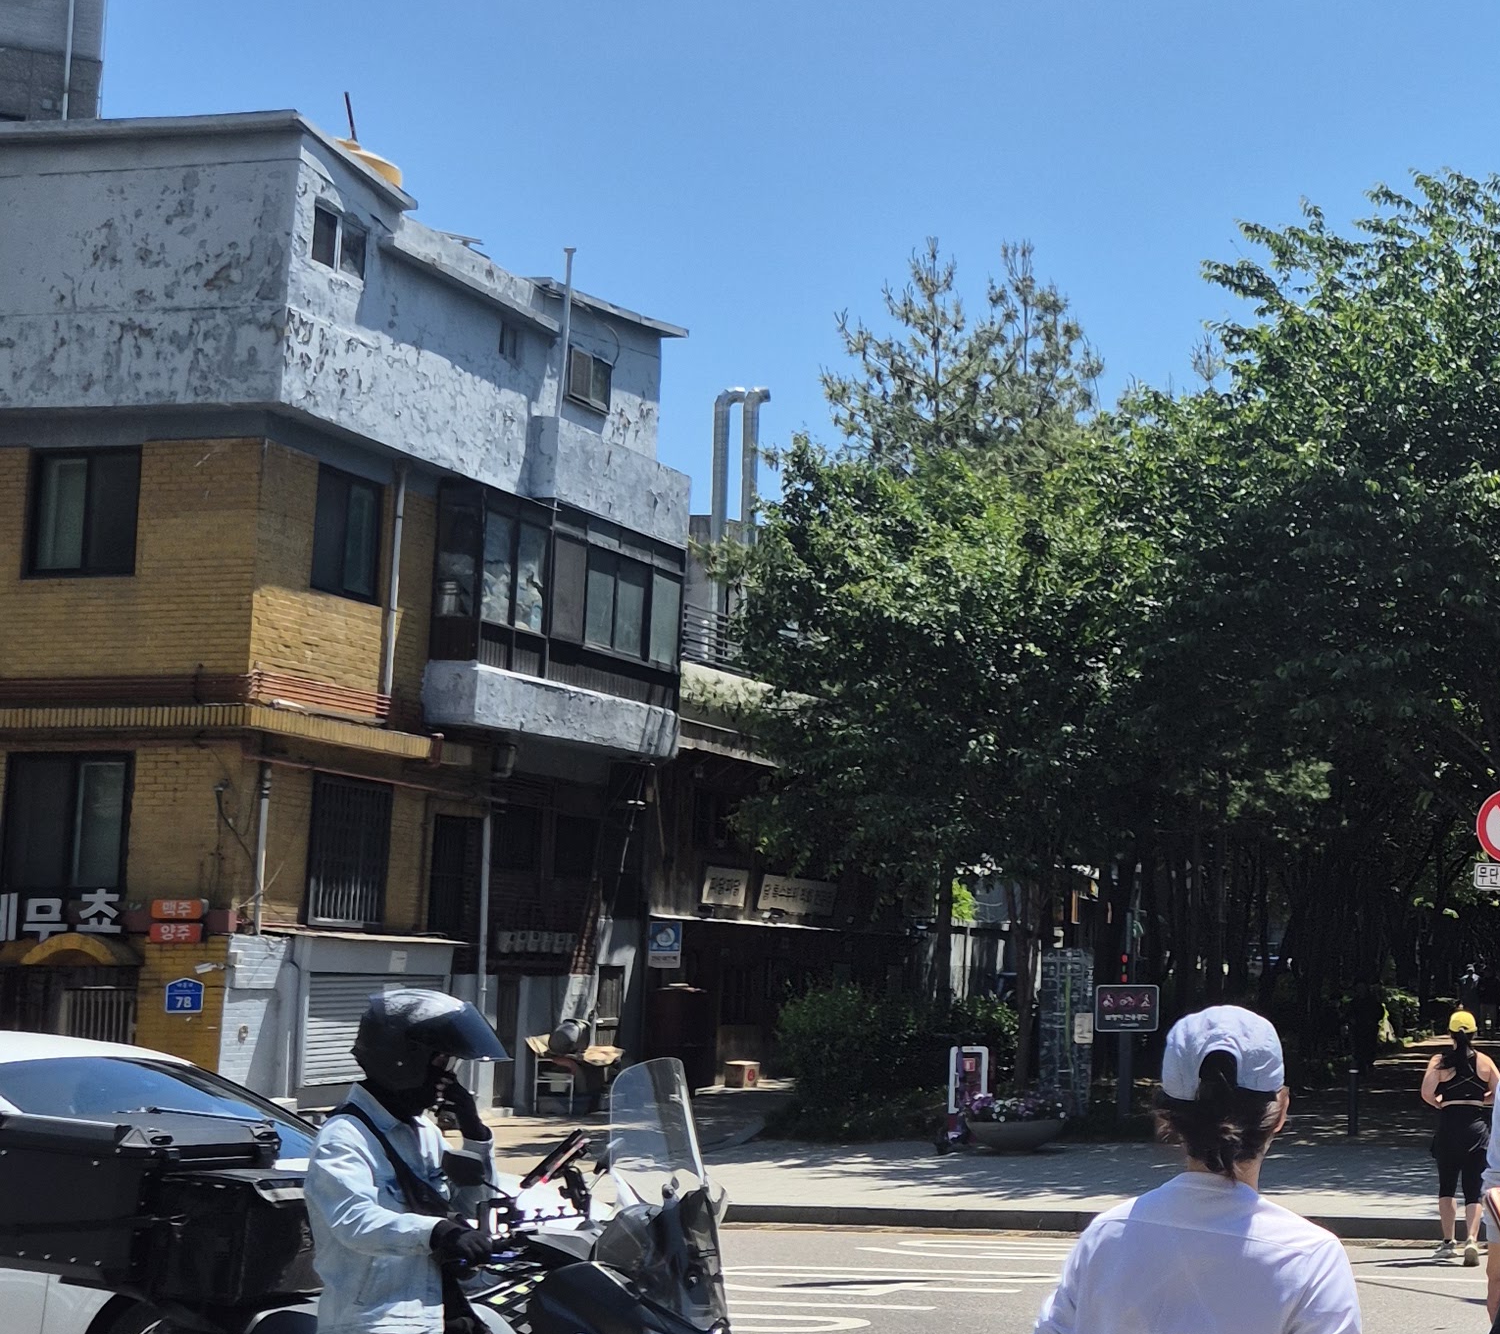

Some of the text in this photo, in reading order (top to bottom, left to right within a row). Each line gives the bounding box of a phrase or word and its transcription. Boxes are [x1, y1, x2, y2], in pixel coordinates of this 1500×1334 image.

[162, 901, 192, 915] 맥주
[161, 924, 191, 940] 양주
[175, 996, 192, 1008] 78
